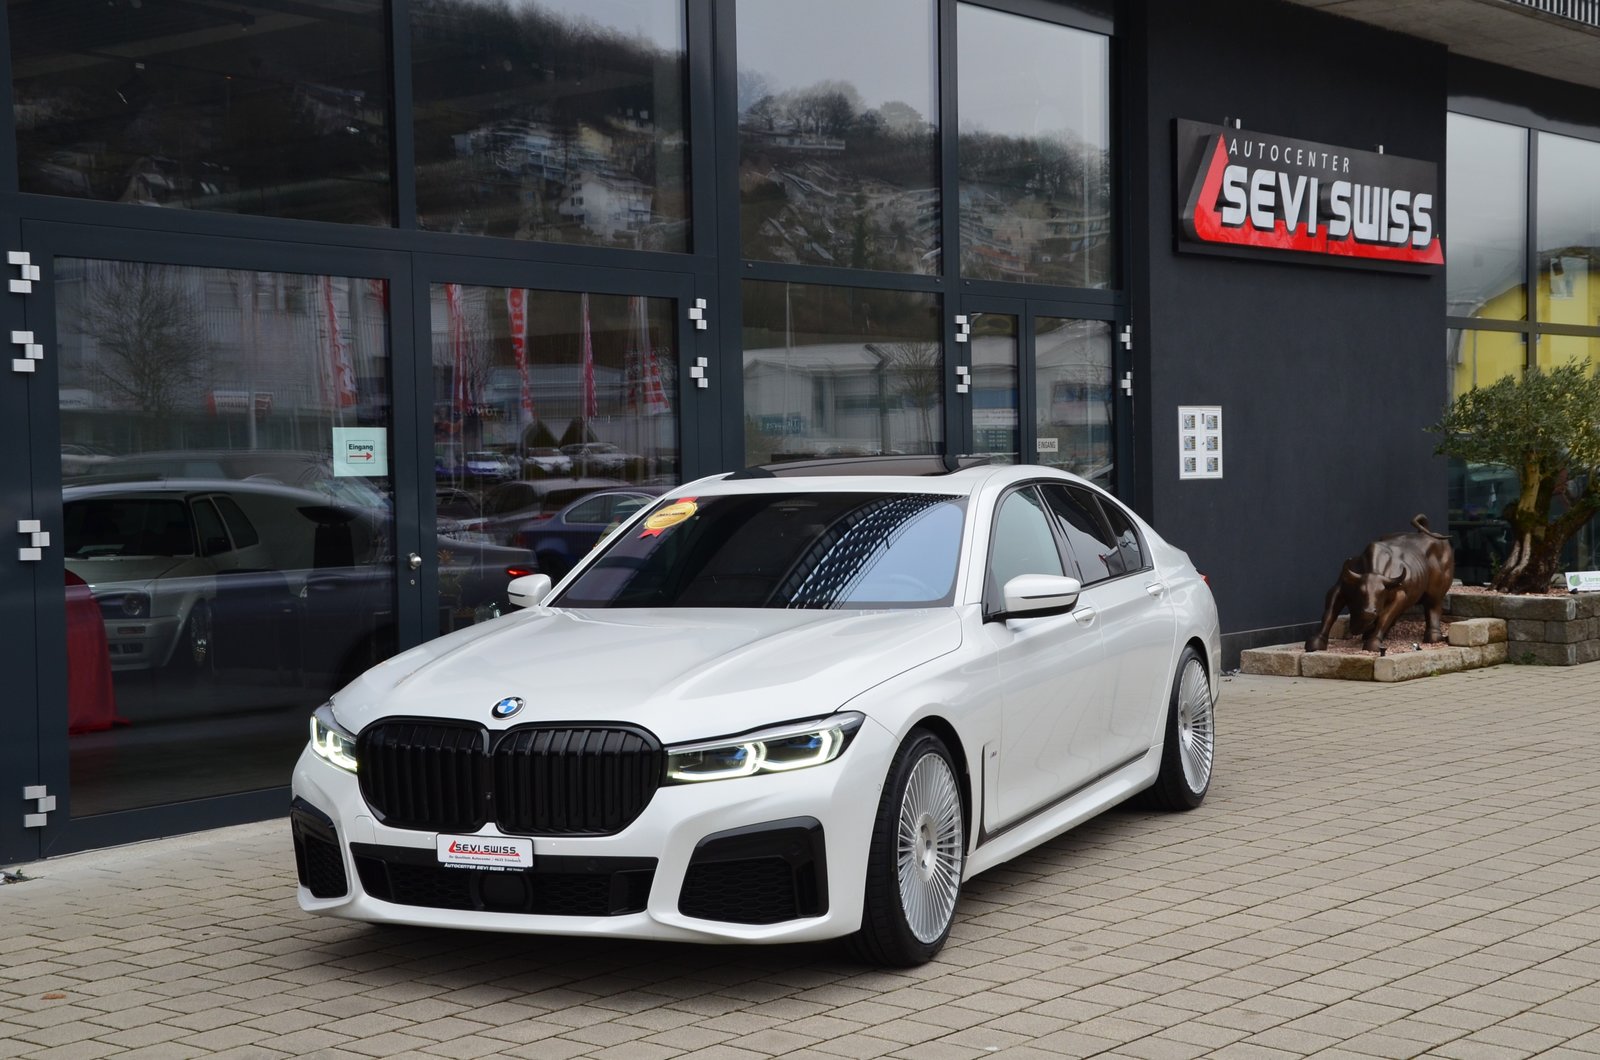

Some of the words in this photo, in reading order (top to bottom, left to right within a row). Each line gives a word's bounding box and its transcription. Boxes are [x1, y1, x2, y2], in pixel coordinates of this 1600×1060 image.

[1229, 138, 1350, 173] AUTOCENTER
[1221, 165, 1318, 234] SEVI
[1328, 180, 1433, 247] SWISS
[348, 443, 374, 451] Eingang
[1037, 441, 1056, 449] EINGANG
[455, 843, 481, 851] SEVI
[484, 845, 516, 854] SWISS
